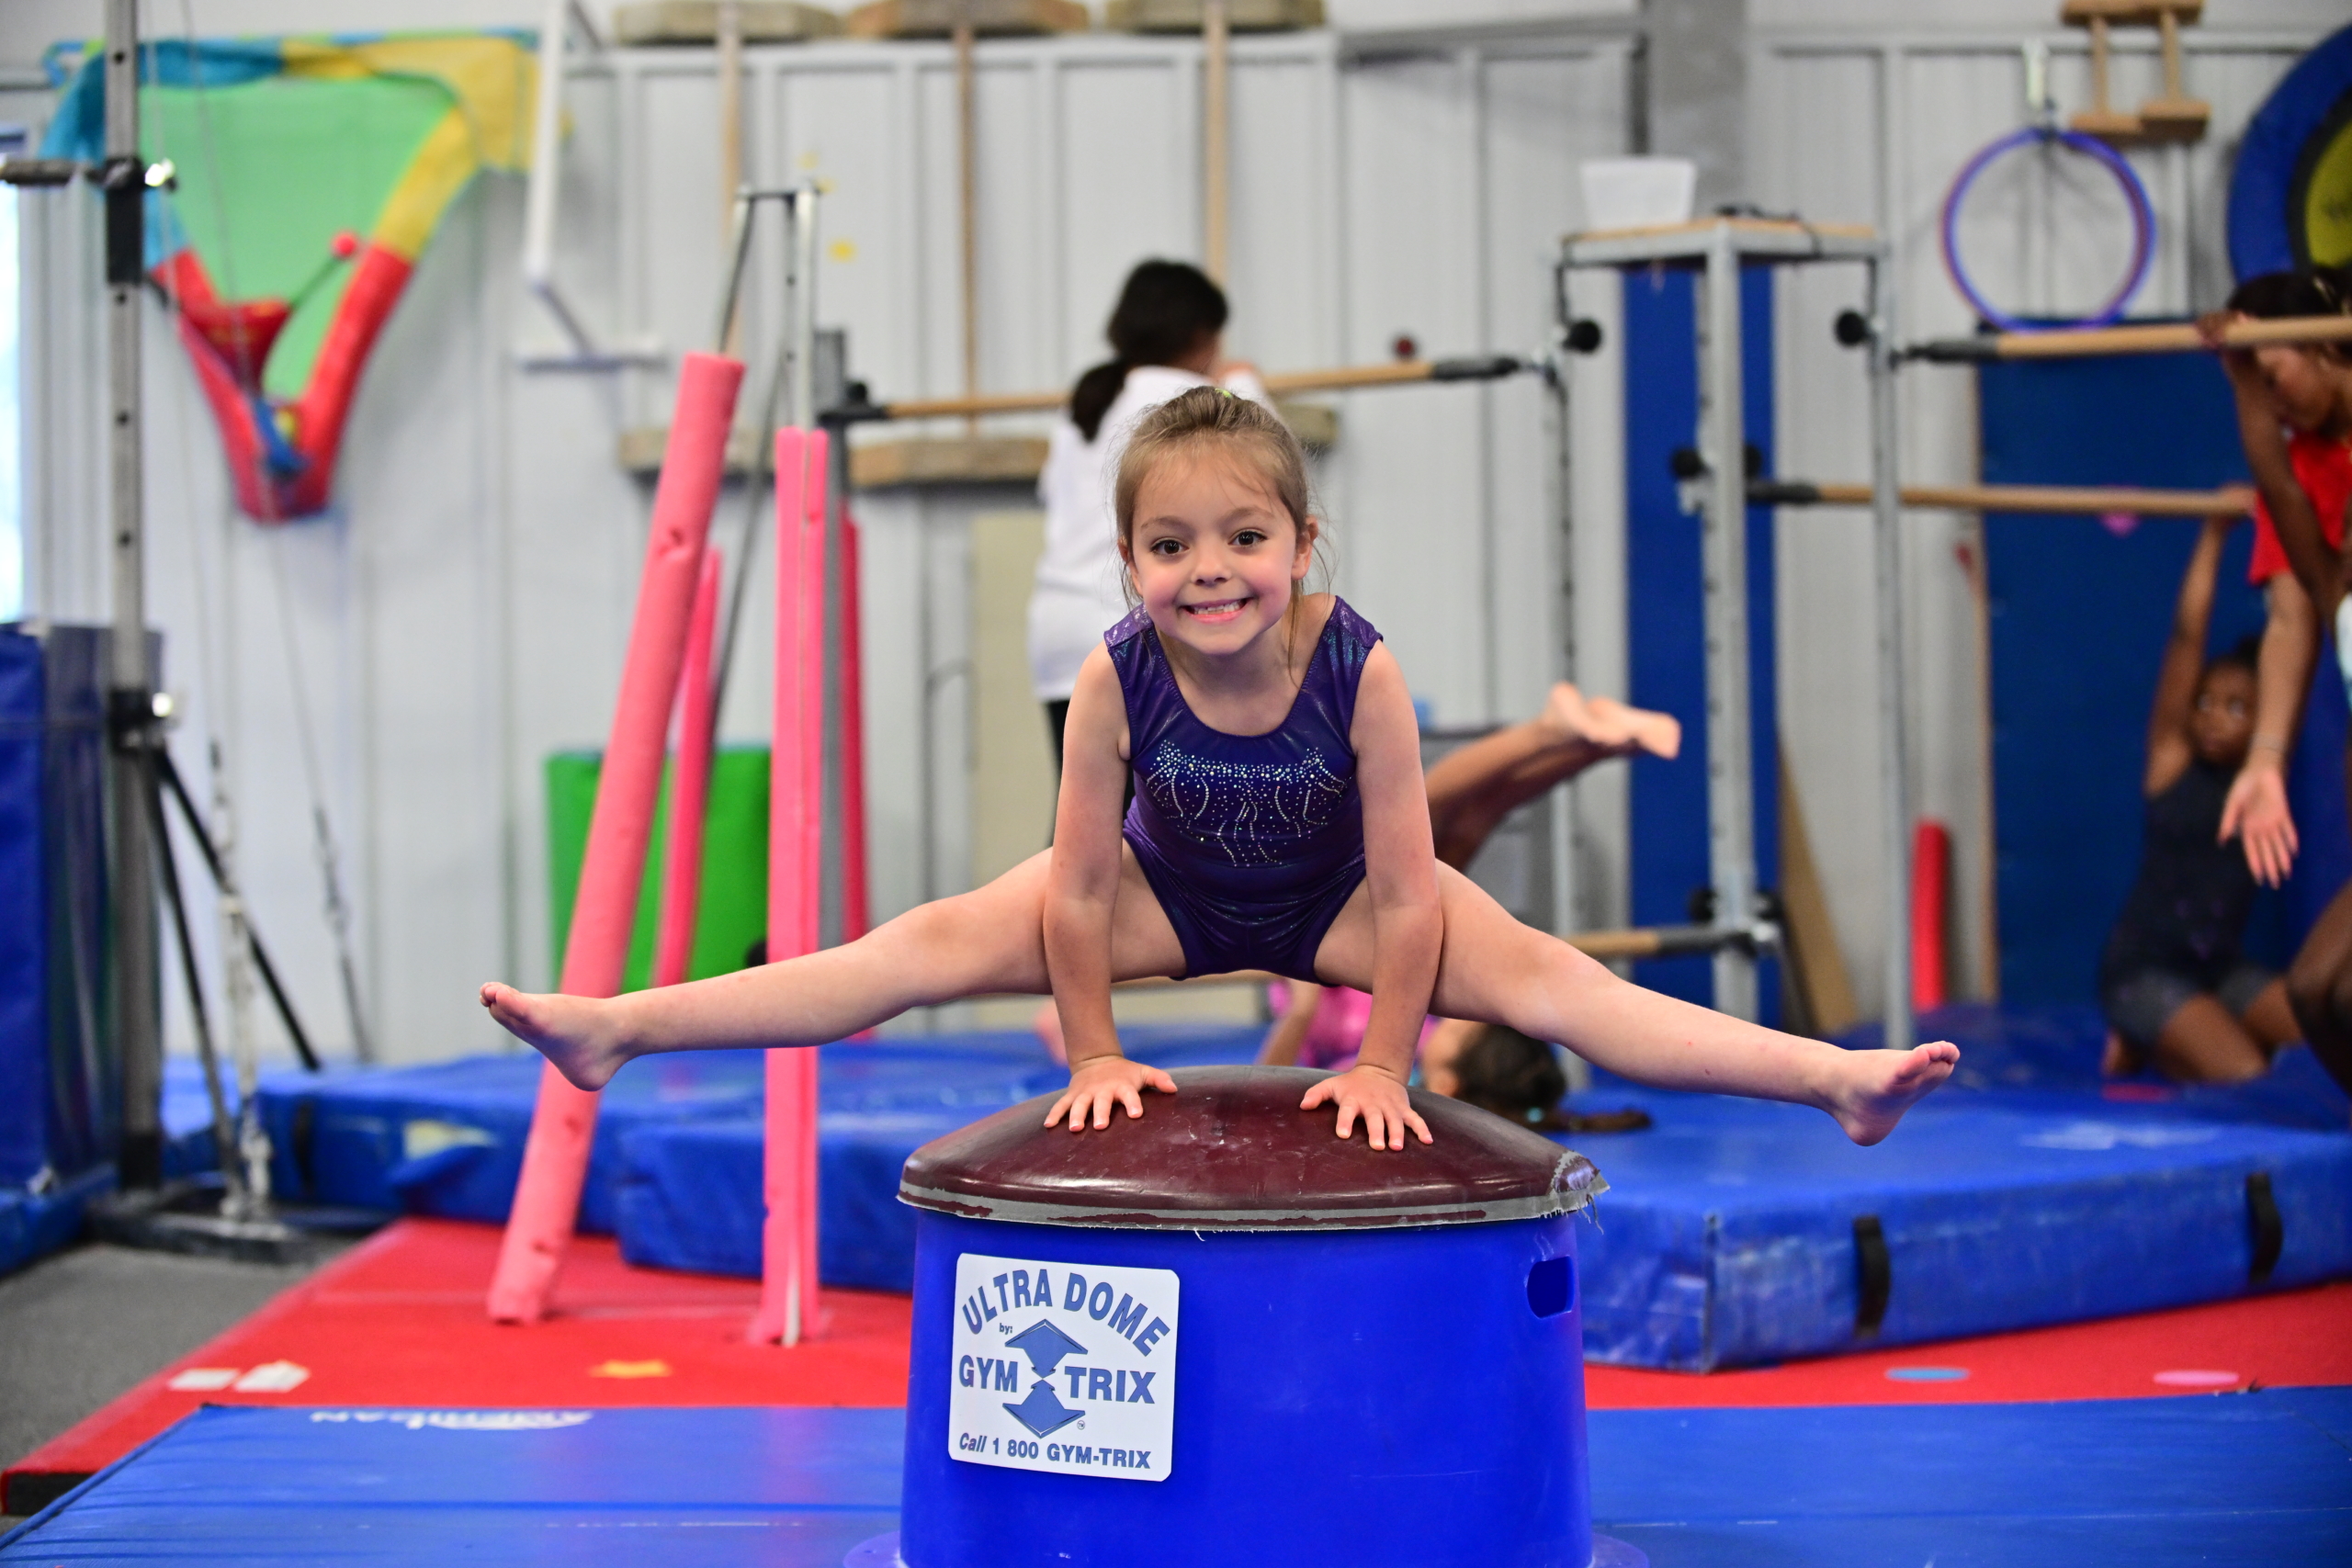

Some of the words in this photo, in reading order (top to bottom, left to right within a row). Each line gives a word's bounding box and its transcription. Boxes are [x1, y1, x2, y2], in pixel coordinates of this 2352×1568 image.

[962, 1269, 1053, 1335] ULTRA
[1063, 1272, 1170, 1357] DOME
[999, 1323, 1012, 1335] by:
[959, 1355, 1018, 1393] GYM
[1064, 1366, 1157, 1404] TRIX
[959, 1433, 987, 1452] Call
[992, 1438, 1000, 1454] 1
[1007, 1439, 1039, 1459] 800
[1046, 1443, 1151, 1469] GYM-TRIX
